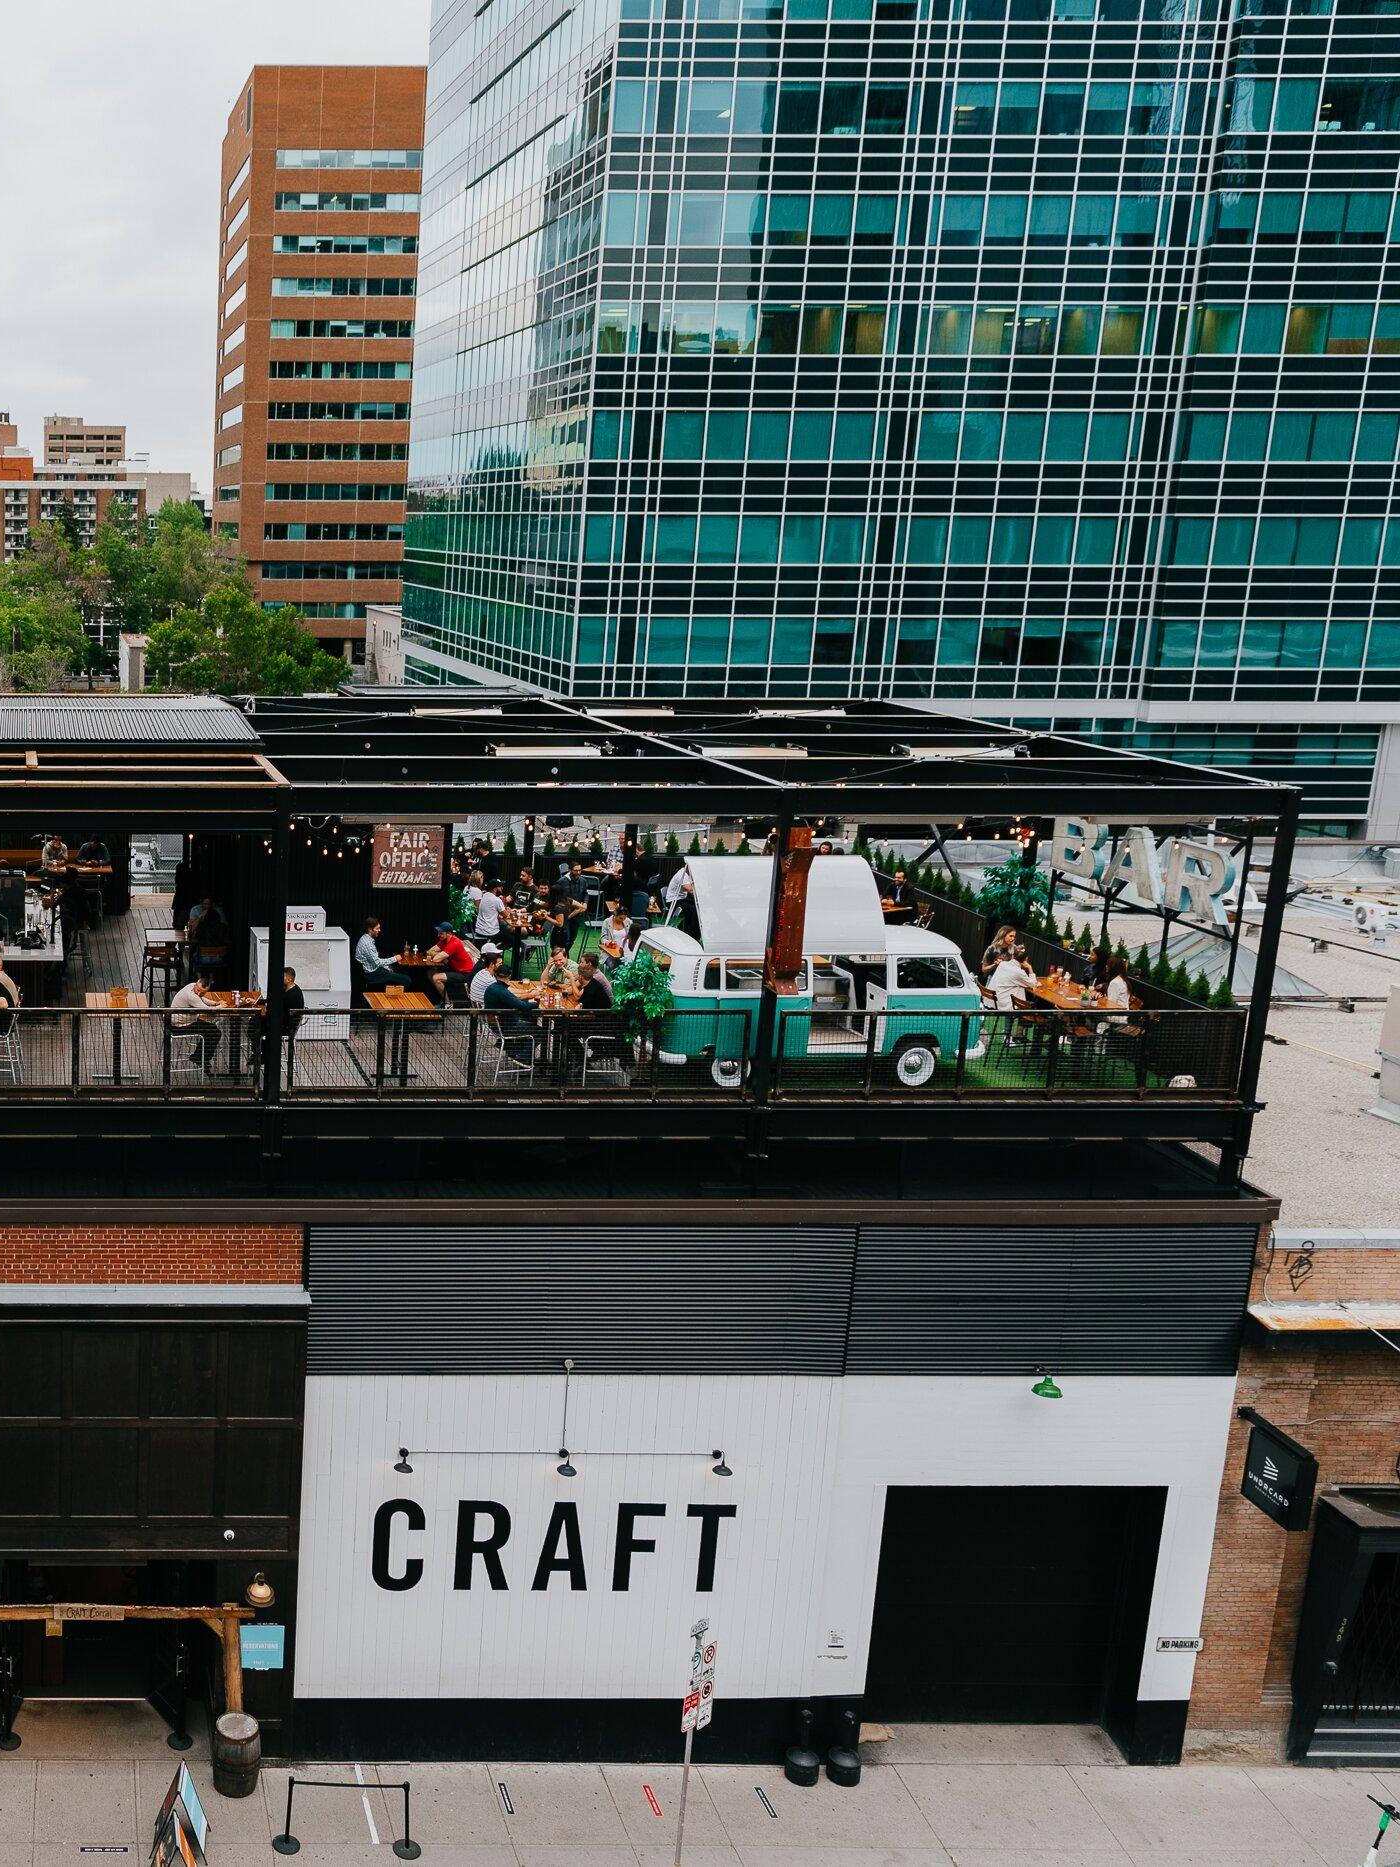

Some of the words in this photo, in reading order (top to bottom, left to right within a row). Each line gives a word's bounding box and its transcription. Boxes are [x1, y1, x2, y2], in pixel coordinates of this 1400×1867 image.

[389, 832, 430, 848] FAIR
[379, 851, 438, 868] OFFICE
[1051, 816, 1236, 926] BAR
[286, 922, 315, 932] ICE
[1248, 1471, 1289, 1507] UNDRCARD
[372, 1498, 738, 1592] CRAFT
[89, 1606, 112, 1619] Corral
[1161, 1640, 1170, 1649] NO
[1170, 1640, 1200, 1649] PARKING
